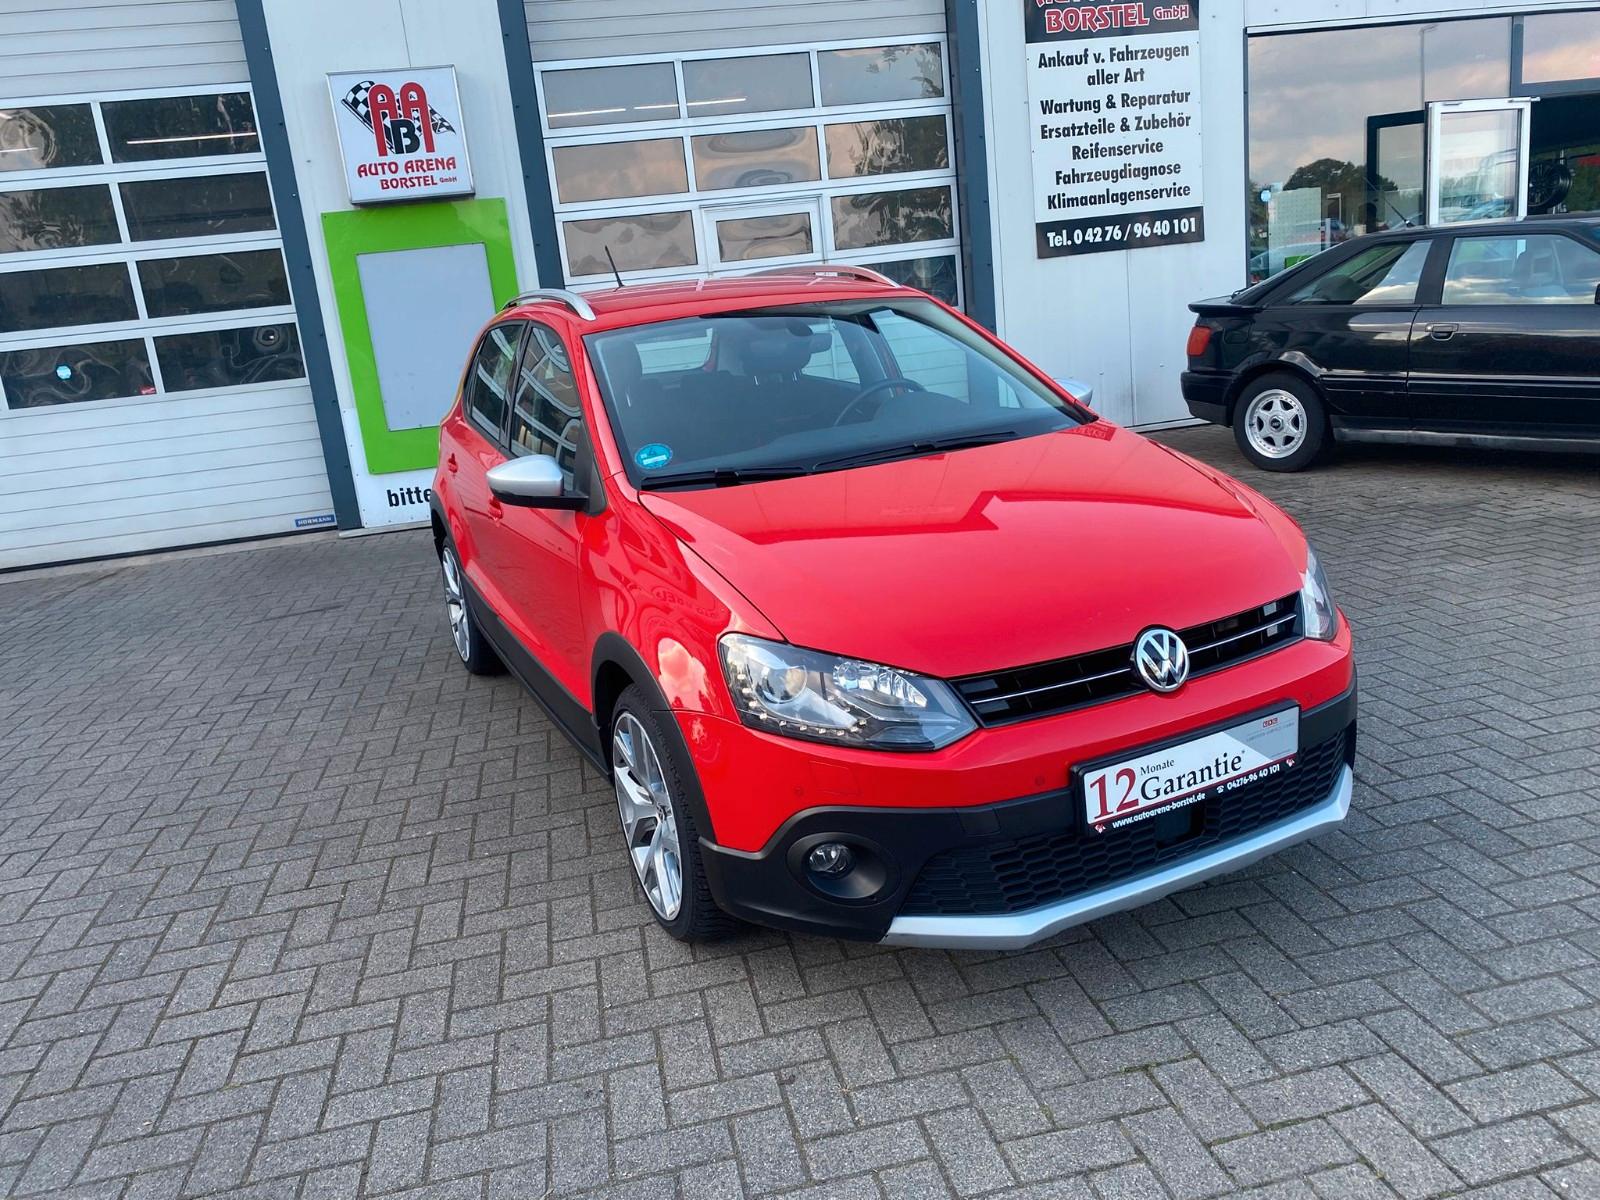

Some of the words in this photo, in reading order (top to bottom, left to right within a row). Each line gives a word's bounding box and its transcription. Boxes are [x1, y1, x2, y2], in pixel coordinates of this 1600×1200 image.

[1045, 3, 1150, 33] BORSTEL
[1153, 5, 1189, 20] GmbH
[1038, 48, 1089, 68] Ankauf
[1093, 53, 1105, 64] v.
[1109, 44, 1190, 63] Fahrzeugen
[1087, 69, 1120, 86] aller
[1124, 68, 1145, 82] Art
[1040, 99, 1101, 115] Wartung
[1106, 94, 1117, 109] &
[1121, 90, 1191, 109] Reparatur
[1041, 118, 1115, 139] Ersatzteile
[1120, 117, 1131, 132] &
[1134, 112, 1191, 131] Zubehör
[1072, 138, 1164, 160] Reifenservice
[357, 161, 399, 178] AUTO
[404, 156, 457, 174] ARENA
[1055, 163, 1181, 185] Fahrzeugdiagnose
[380, 175, 438, 190] BORSTEL
[1047, 182, 1191, 210] Klimaanlagenservice
[1047, 229, 1072, 248] Tel.
[386, 486, 432, 507] bitte
[1140, 758, 1175, 776] Monate
[1090, 767, 1139, 820] 12
[1112, 792, 1206, 829] www.autoarena-borstel.de
